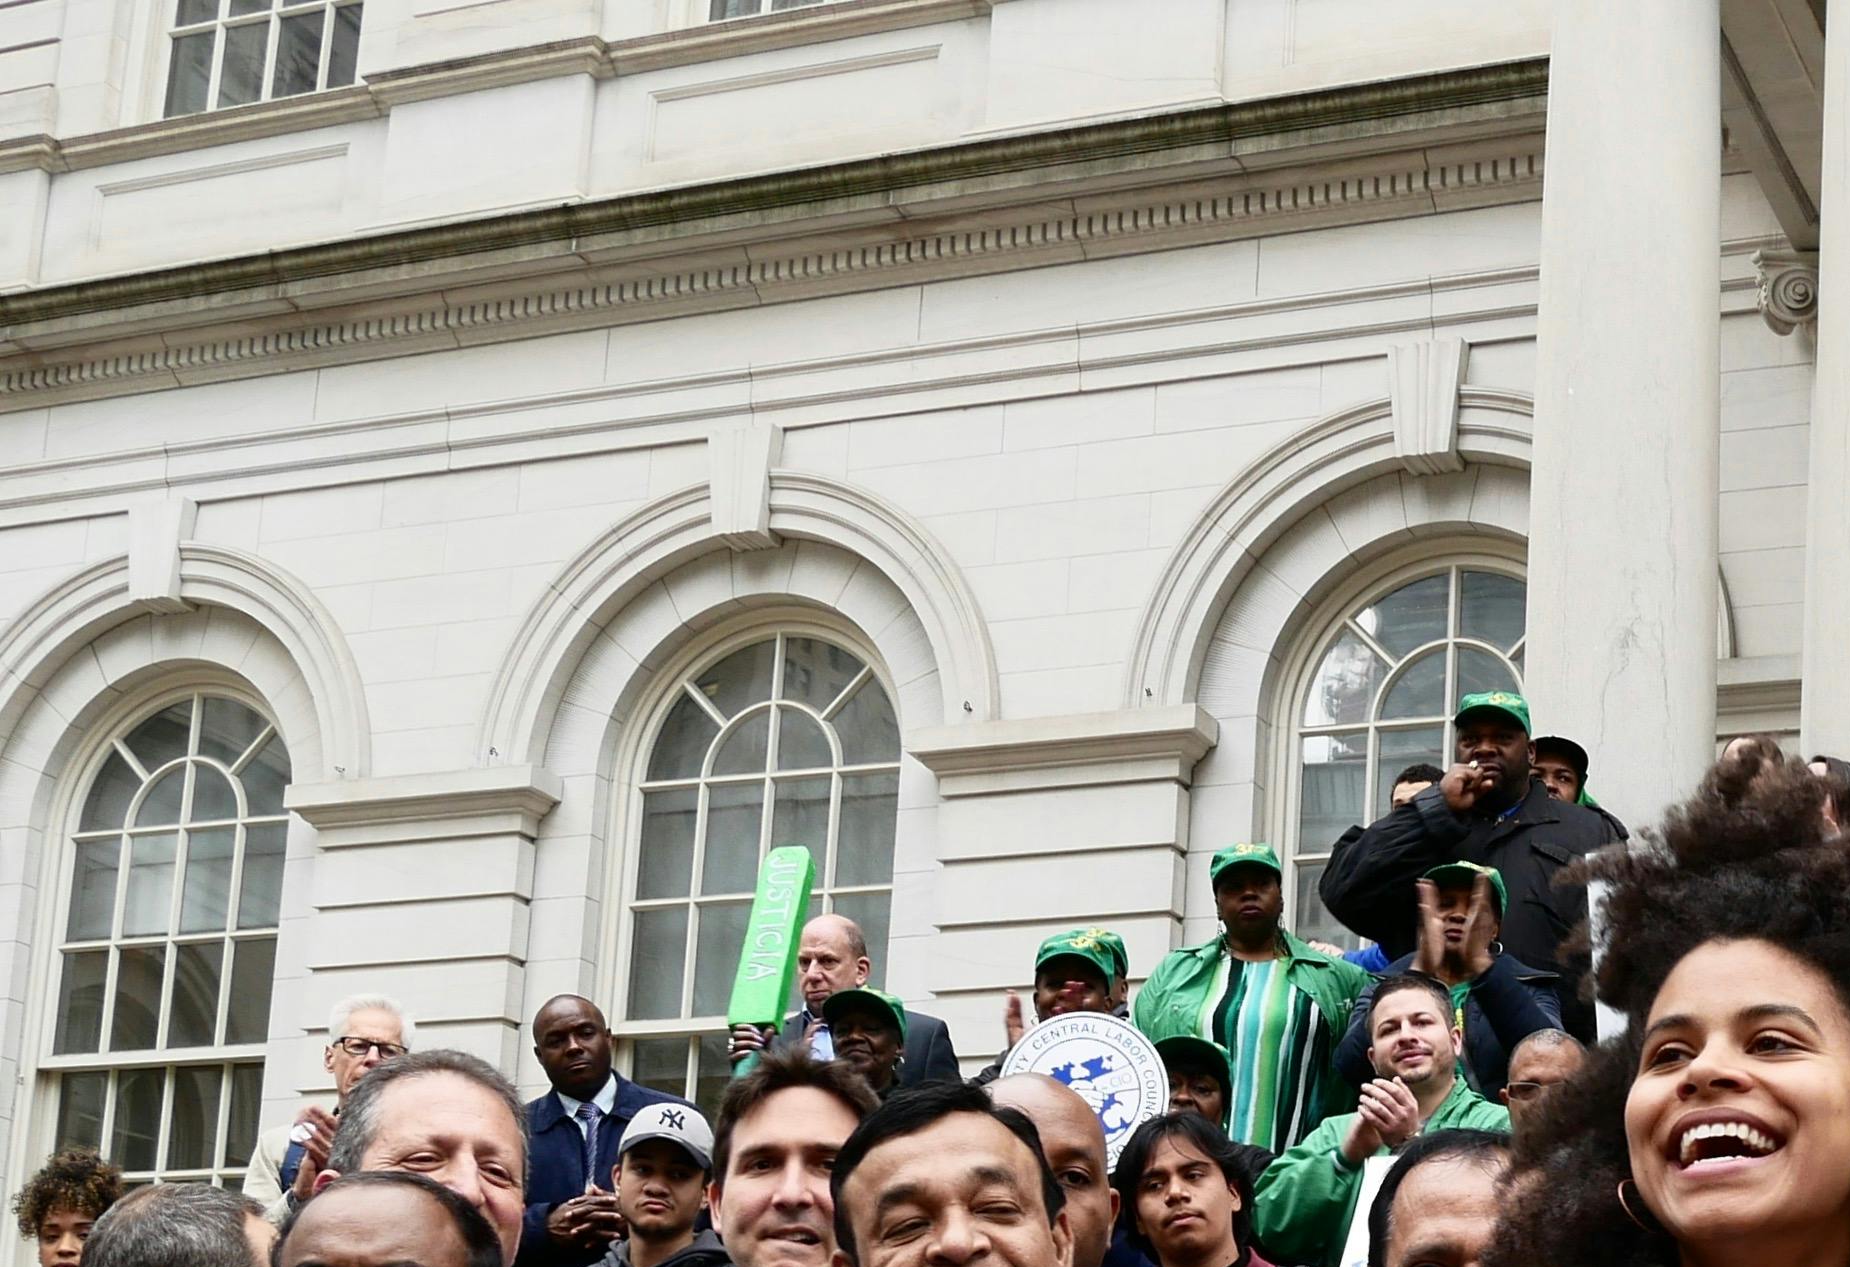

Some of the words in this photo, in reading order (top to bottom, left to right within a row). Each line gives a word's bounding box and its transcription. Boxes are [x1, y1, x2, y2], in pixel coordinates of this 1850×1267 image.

[746, 855, 798, 982] JUSTICIA
[659, 1108, 686, 1131] NY
[1032, 1022, 1099, 1052] CENTRAL
[1105, 1026, 1148, 1066] LABOR
[1143, 1068, 1158, 1125] COUNC
